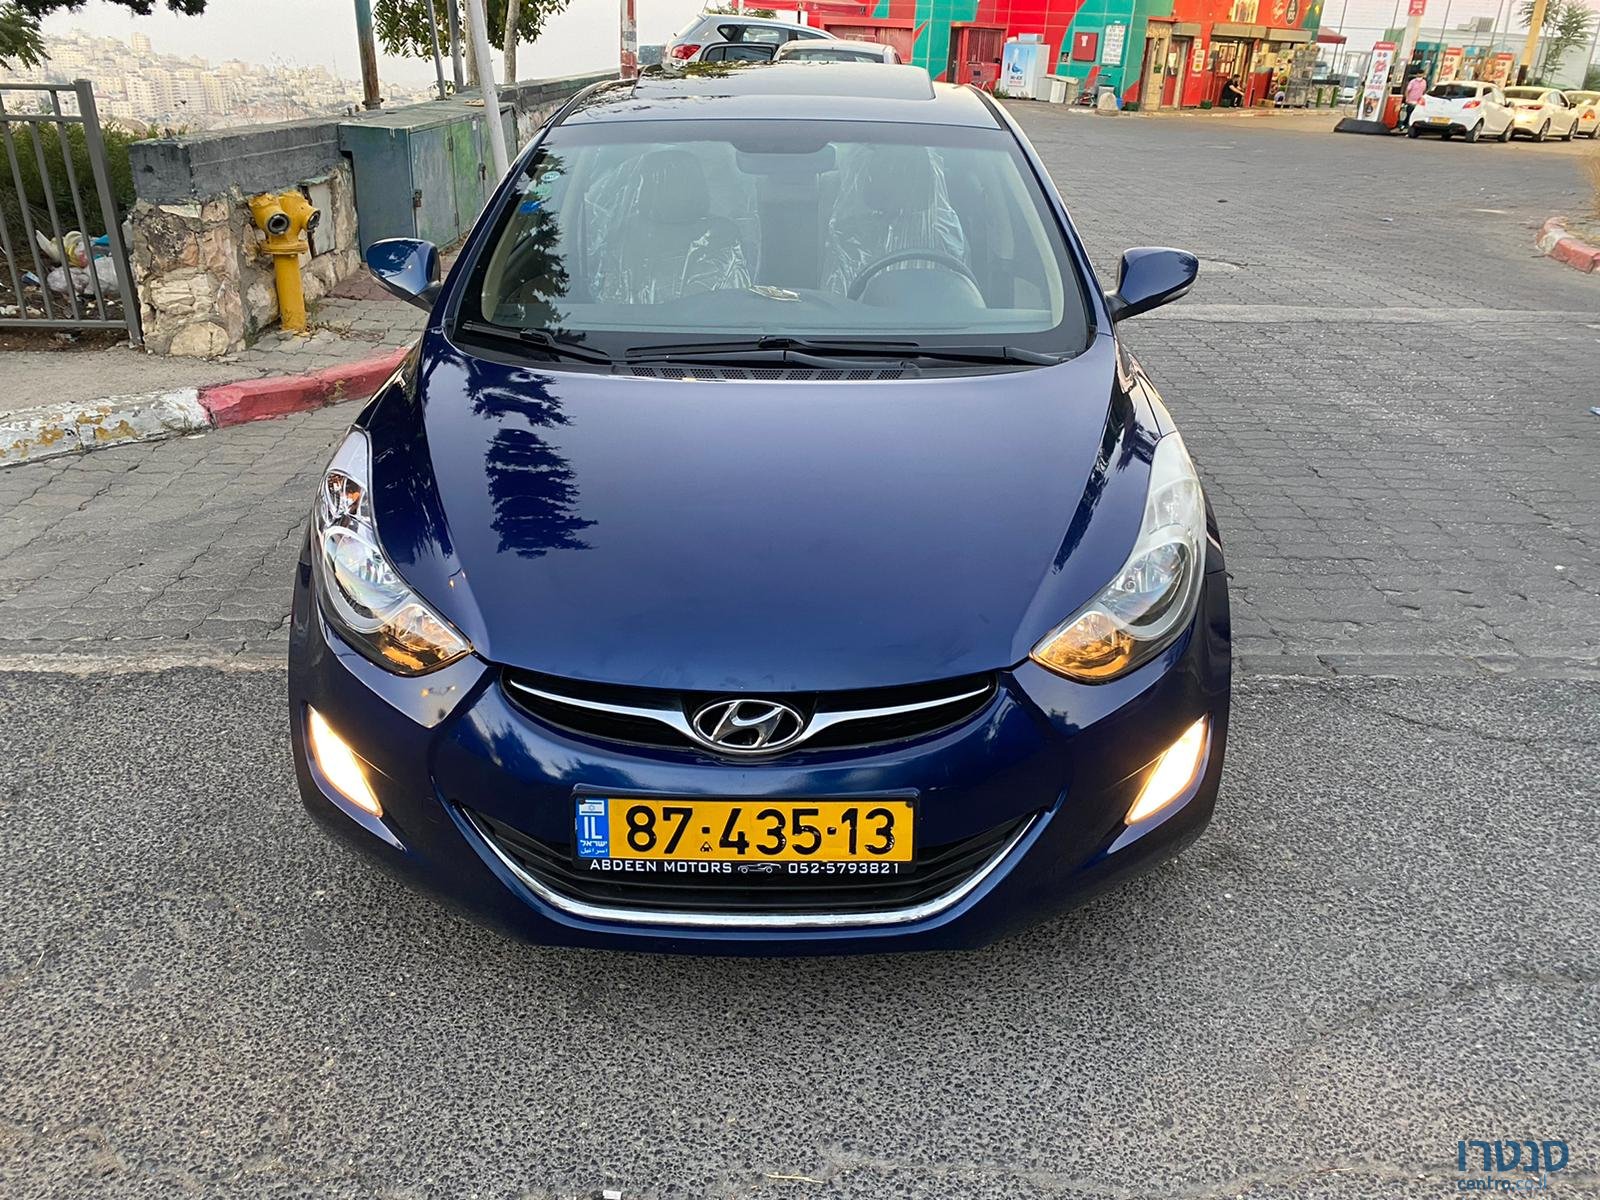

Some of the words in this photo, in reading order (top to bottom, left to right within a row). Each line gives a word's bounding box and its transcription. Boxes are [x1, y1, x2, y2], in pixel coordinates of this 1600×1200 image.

[584, 816, 603, 839] IL
[580, 839, 608, 847] ישראל
[590, 859, 658, 873] ABDEEN
[664, 861, 733, 874] MOTORS
[787, 862, 900, 875] 052-5793821
